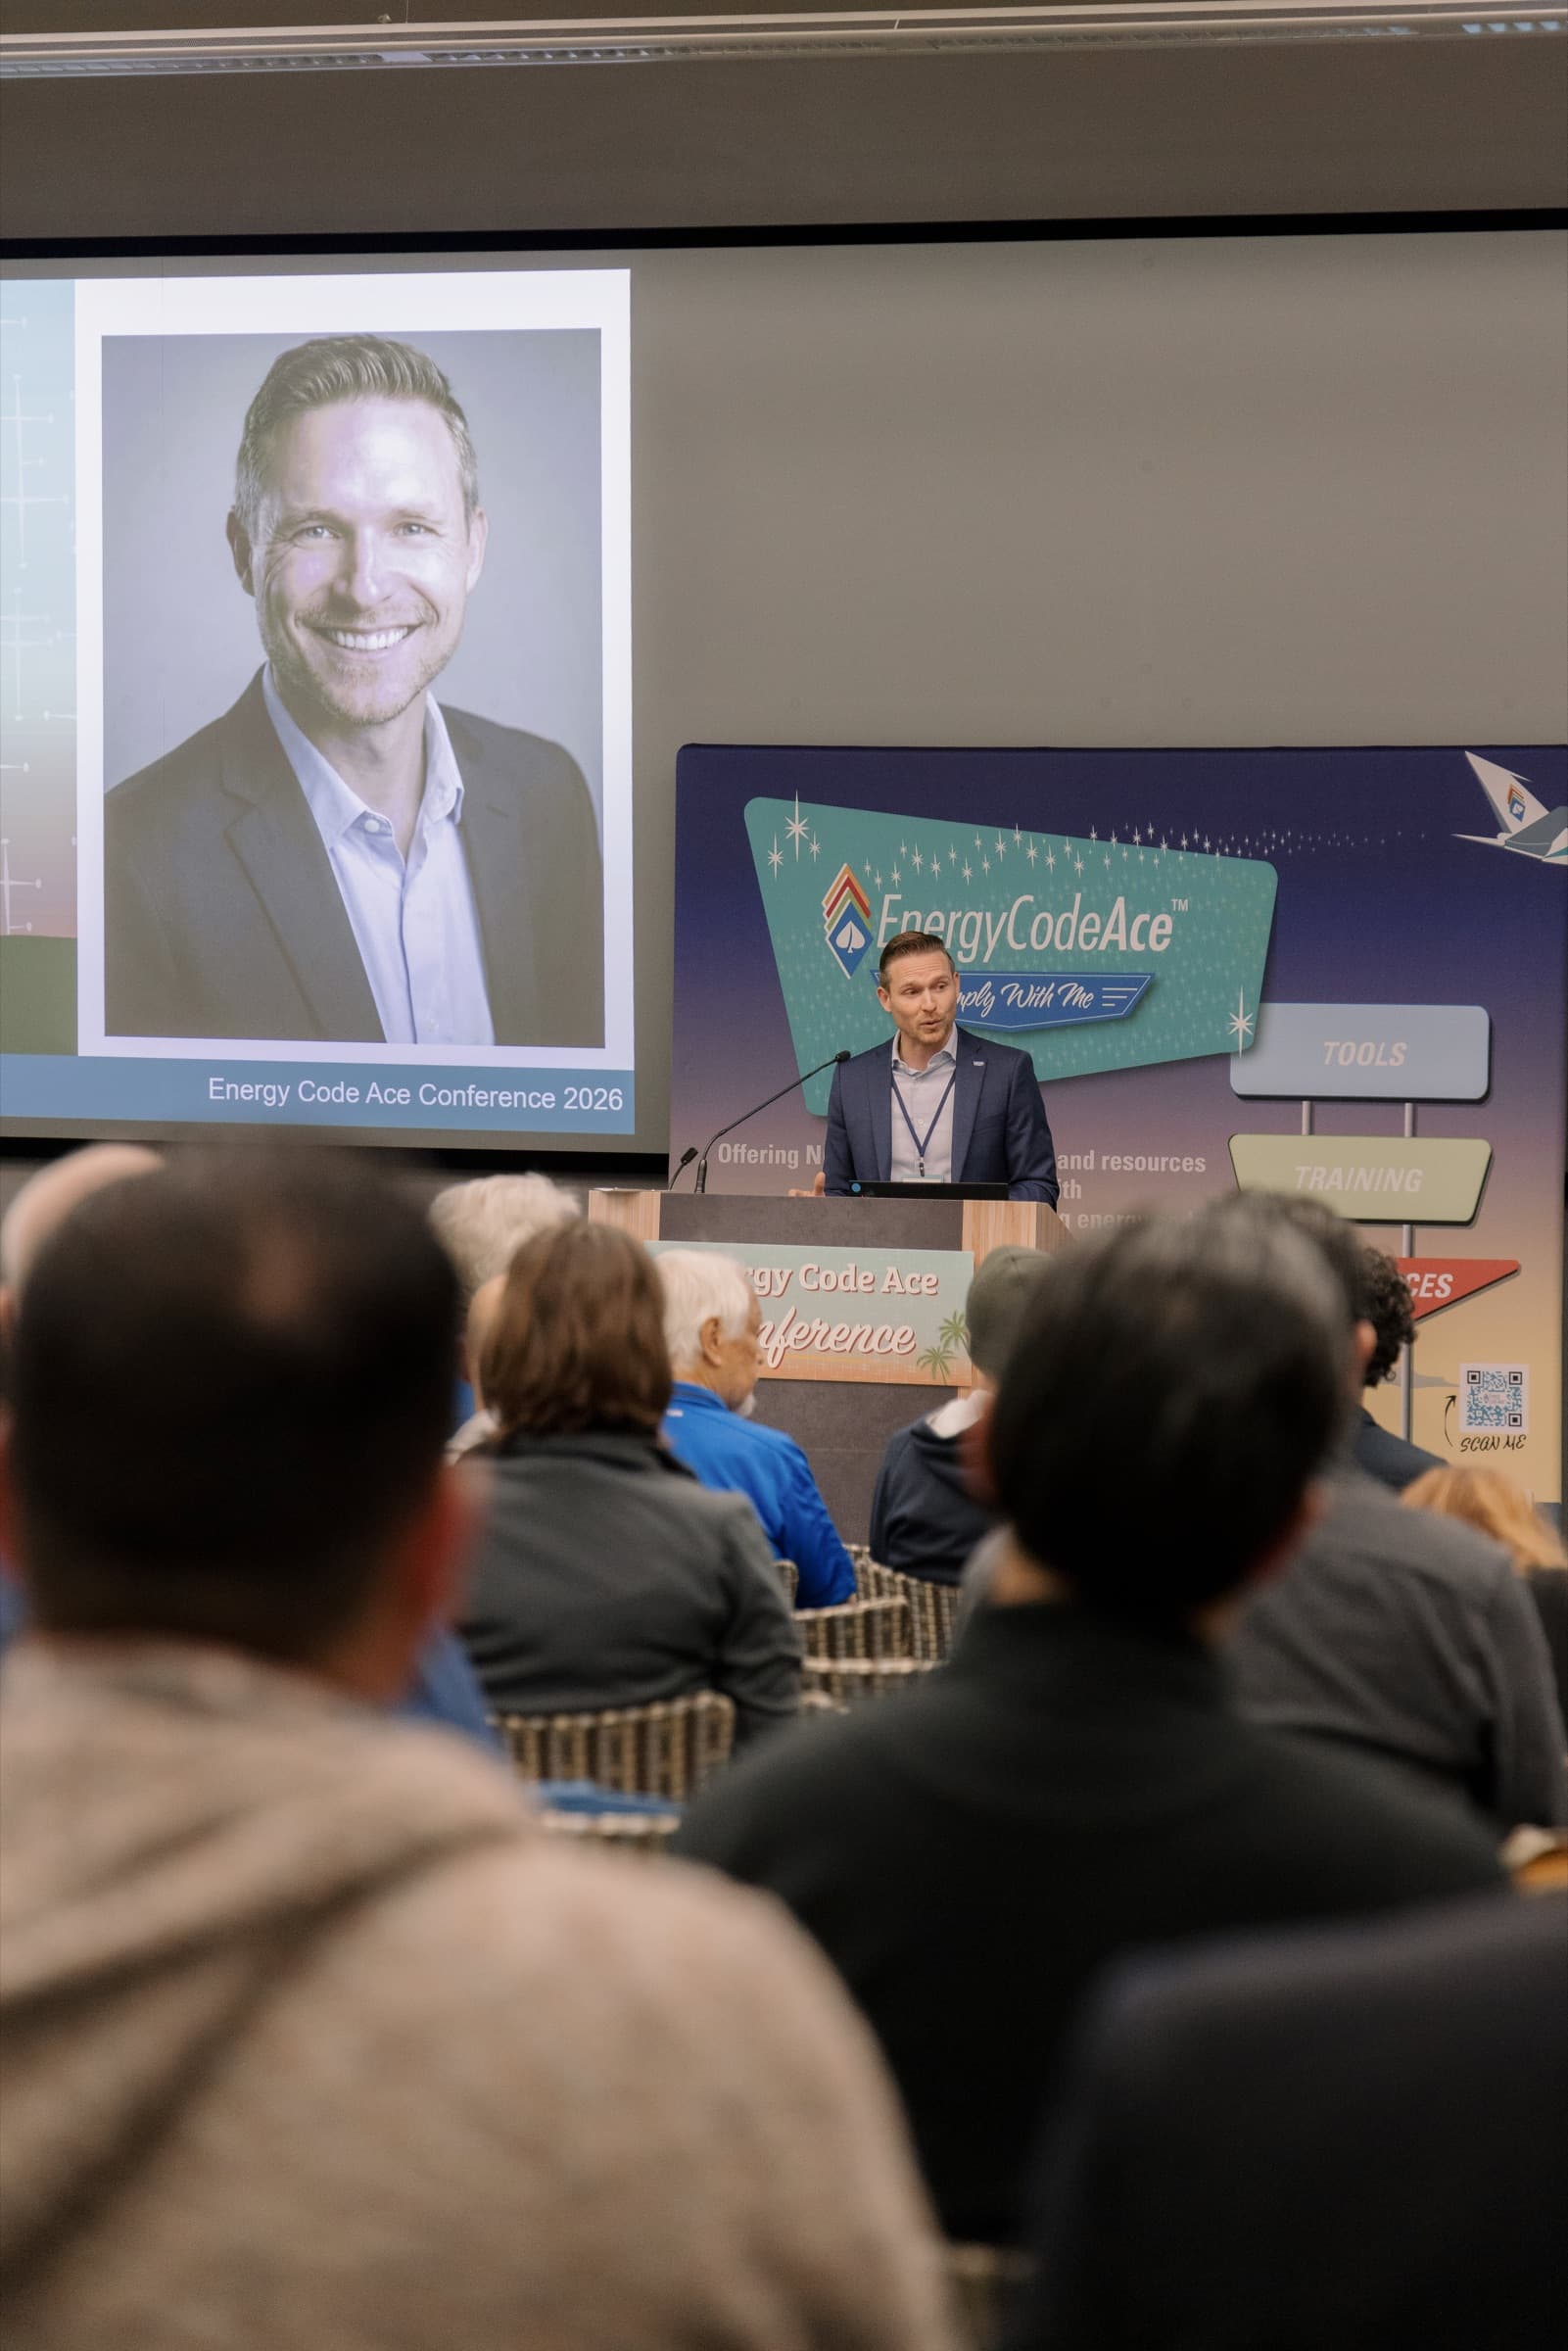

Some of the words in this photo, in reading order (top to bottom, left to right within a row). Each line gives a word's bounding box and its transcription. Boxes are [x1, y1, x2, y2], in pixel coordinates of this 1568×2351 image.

[1000, 982, 1055, 1009] With
[1058, 982, 1095, 1009] Me
[1323, 1040, 1407, 1067] TOOLS
[209, 1078, 290, 1107] Energy
[297, 1080, 359, 1103] Code
[365, 1081, 410, 1105] Ace
[418, 1083, 555, 1109] Conference
[563, 1087, 623, 1111] 2026
[718, 1143, 799, 1170] Offering
[1057, 1150, 1095, 1171] and
[1101, 1155, 1207, 1173] resources
[1058, 1178, 1082, 1200] ith
[1294, 1165, 1424, 1192] TRAINING
[798, 1263, 876, 1293] Code
[881, 1266, 939, 1296] Ace
[1460, 1435, 1500, 1453] SCAN
[1503, 1434, 1527, 1451] ME
